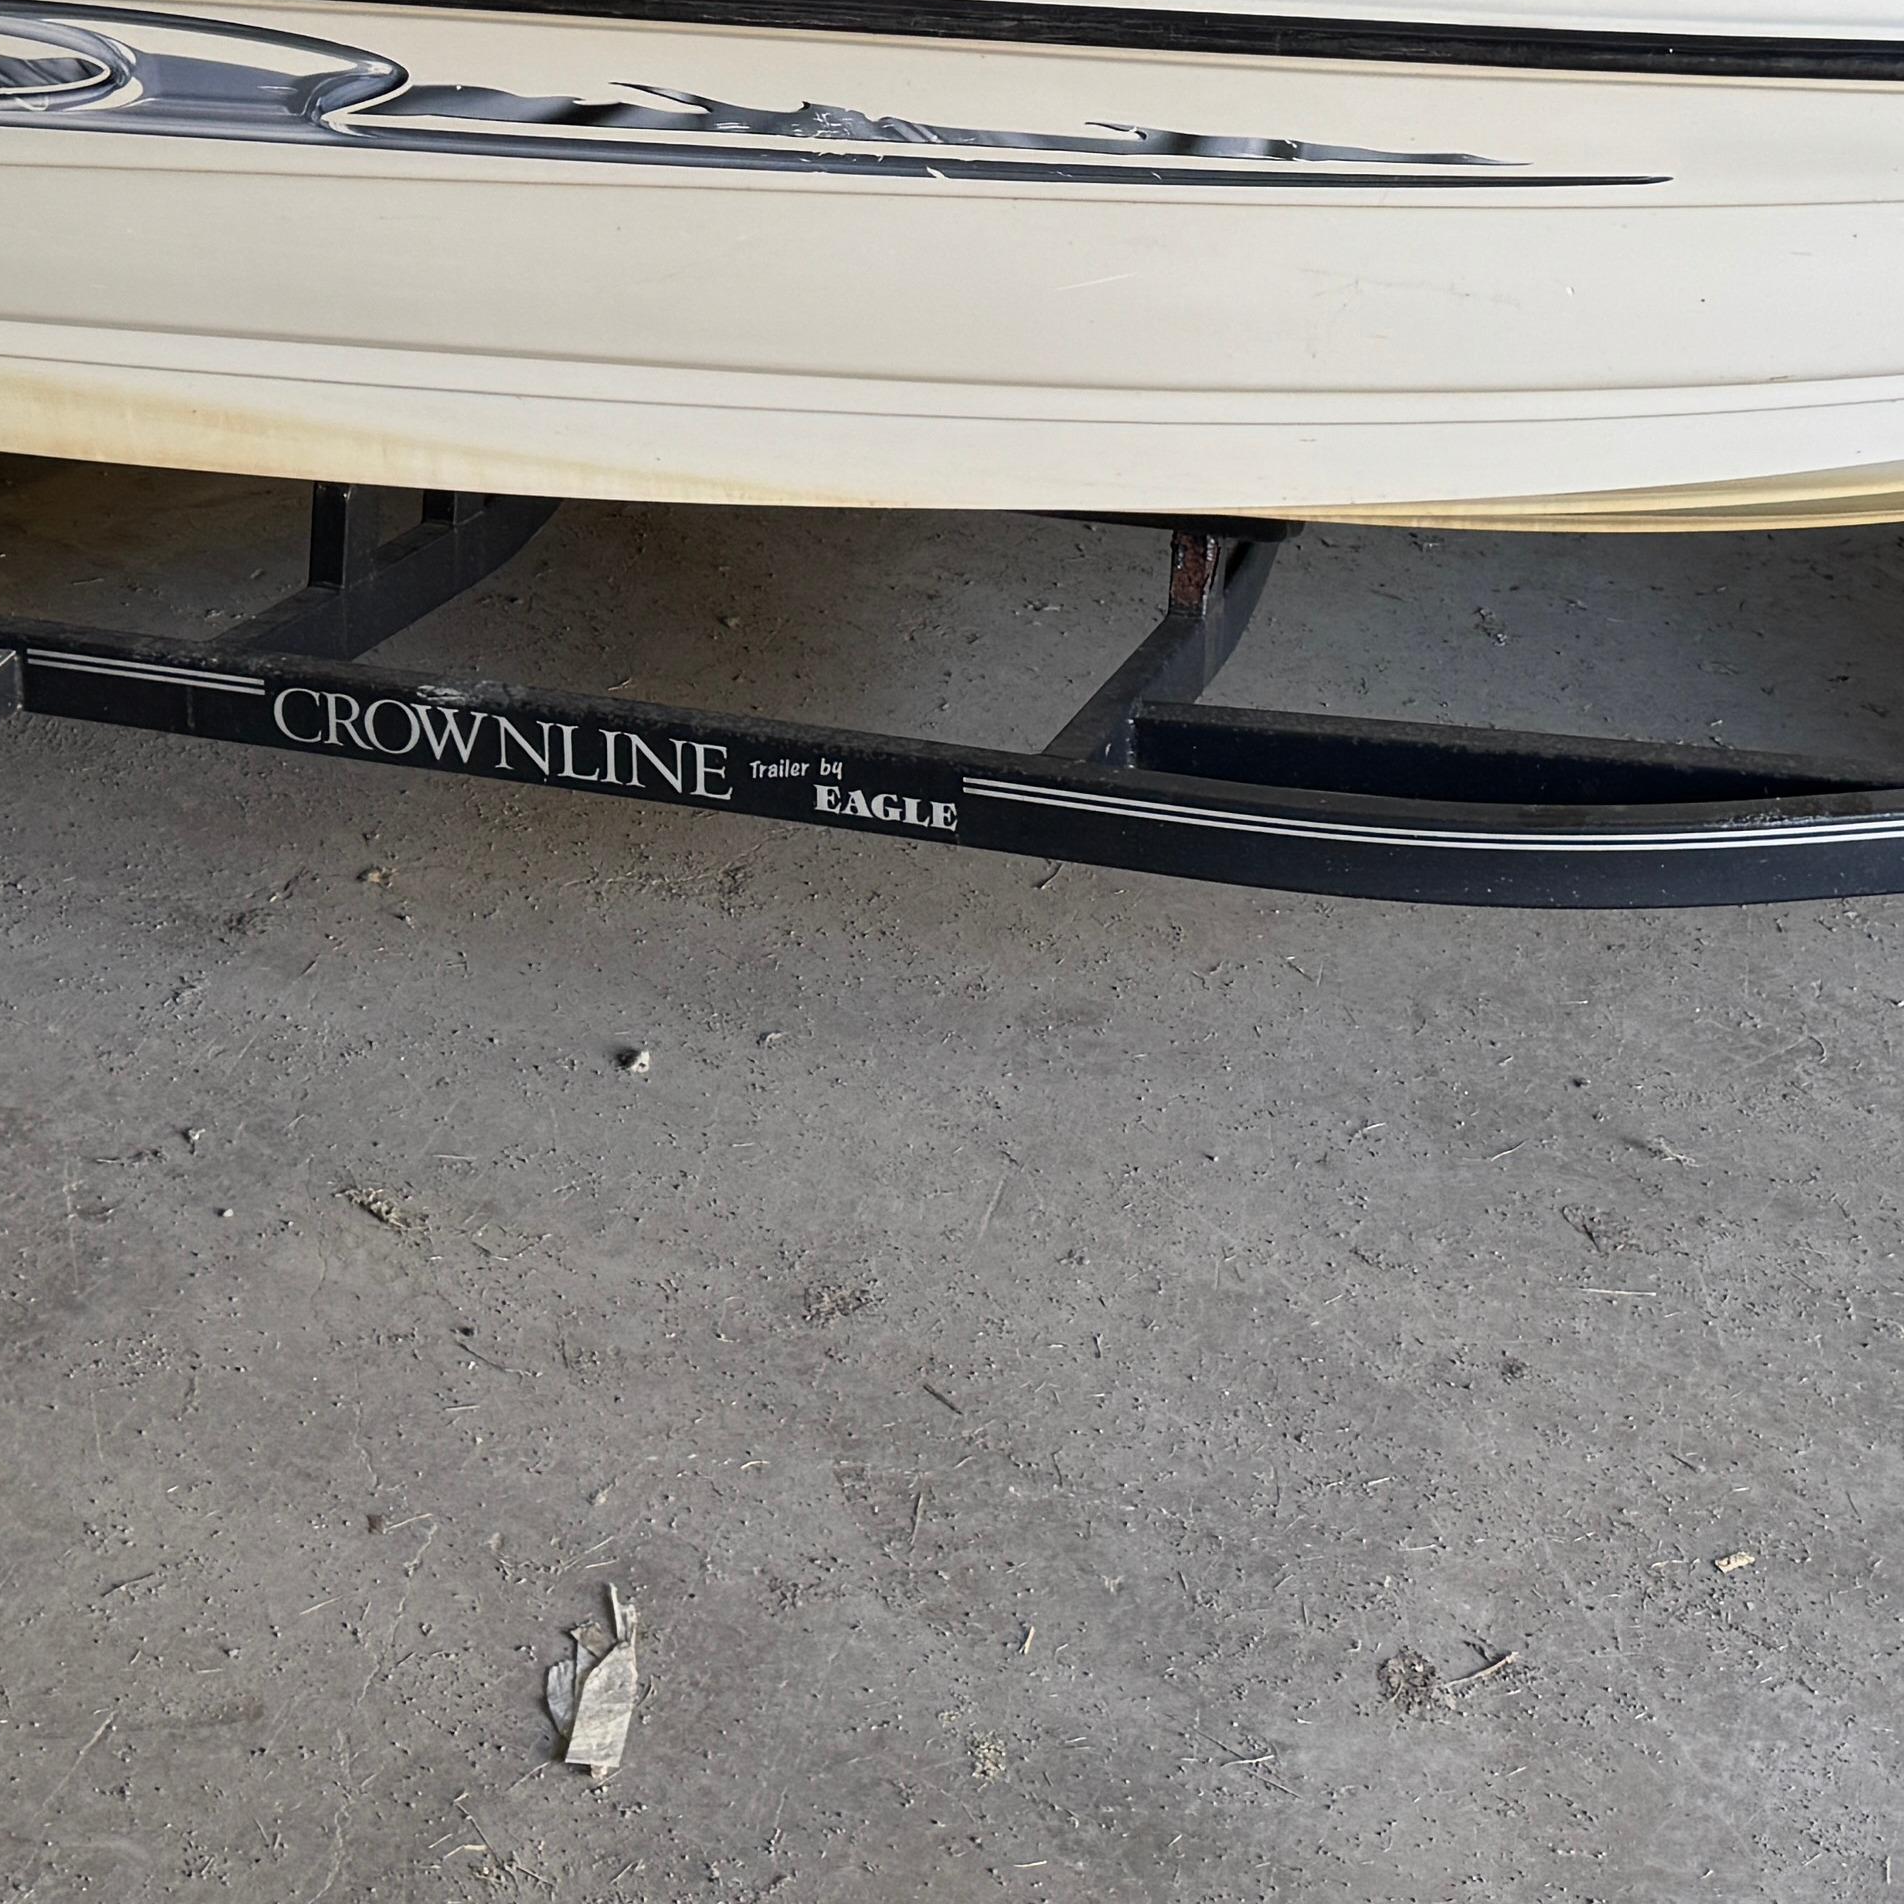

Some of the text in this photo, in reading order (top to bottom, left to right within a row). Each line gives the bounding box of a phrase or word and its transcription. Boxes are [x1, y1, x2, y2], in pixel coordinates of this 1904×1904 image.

[273, 687, 733, 801] CROWNLINE
[749, 757, 843, 781] Trailer by
[813, 783, 958, 832] EAGLE
